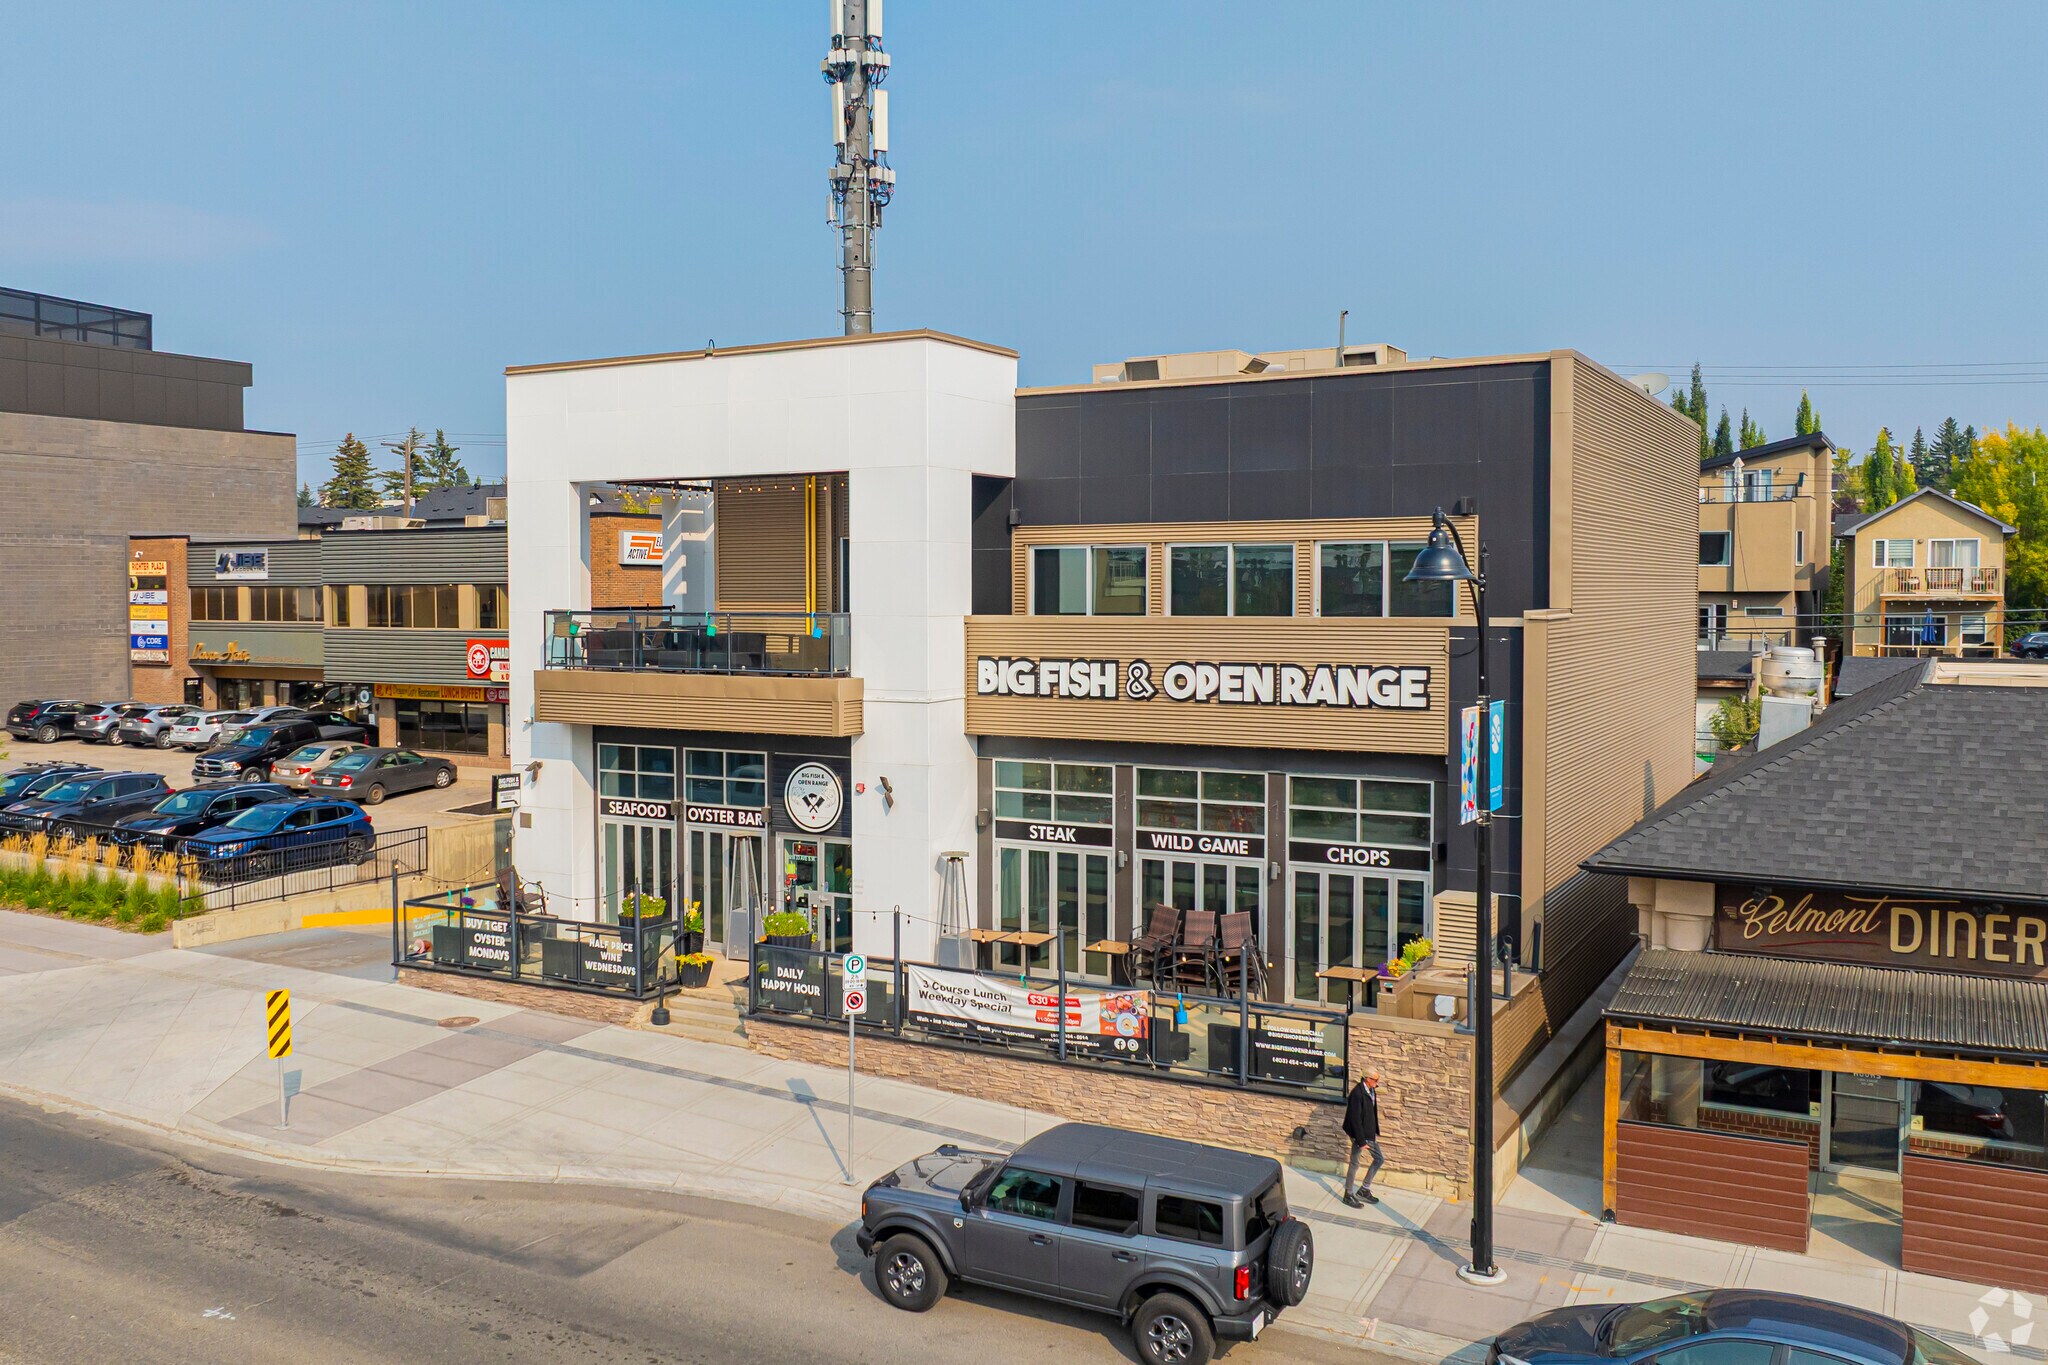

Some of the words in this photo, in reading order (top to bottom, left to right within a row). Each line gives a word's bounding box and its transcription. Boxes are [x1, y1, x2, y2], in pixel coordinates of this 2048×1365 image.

[230, 553, 265, 568] JIBE
[627, 549, 647, 559] ACTIVE
[151, 562, 165, 571] PLAZA
[146, 637, 162, 645] CORE
[978, 657, 1037, 696] BIG
[1039, 658, 1119, 700] FISH
[1125, 658, 1159, 701] &
[1163, 661, 1276, 704] OPEN
[1280, 663, 1431, 710] RANGE
[441, 687, 460, 699] LUNCH
[461, 688, 482, 700] BUFFET
[608, 801, 667, 818] SEAFOOD
[687, 807, 735, 824] OYSTER
[738, 811, 763, 826] BAR
[1029, 825, 1077, 843] STEAK
[1151, 833, 1194, 851] WILD
[1198, 836, 1249, 855] GAME
[1326, 847, 1391, 866] CHOPS
[1740, 893, 1890, 940] Belmont
[466, 918, 483, 930] BUY
[485, 919, 490, 930] 1
[490, 920, 508, 933] GET
[474, 933, 506, 947] OYSTER
[589, 938, 609, 949] HALF
[611, 941, 634, 953] PRICE
[469, 946, 510, 961] MONDAYS
[600, 951, 622, 963] WINE
[585, 960, 636, 976] WEDNESDAYS
[777, 966, 804, 980] DAILY
[761, 978, 792, 992] HAPPY
[793, 982, 821, 996] HOUR
[923, 980, 929, 989] 3
[932, 981, 970, 996] Course
[973, 988, 1007, 1002] Lunch
[918, 989, 967, 1008] Weekday
[970, 998, 1012, 1014] Special
[1029, 995, 1048, 1005] $30
[976, 1024, 991, 1032] Book
[1267, 1025, 1290, 1033] FOLLOW
[1302, 1028, 1324, 1037] SOCIALS
[1255, 1041, 1337, 1057] WWW.BIGFISHOPENRANGE.COM
